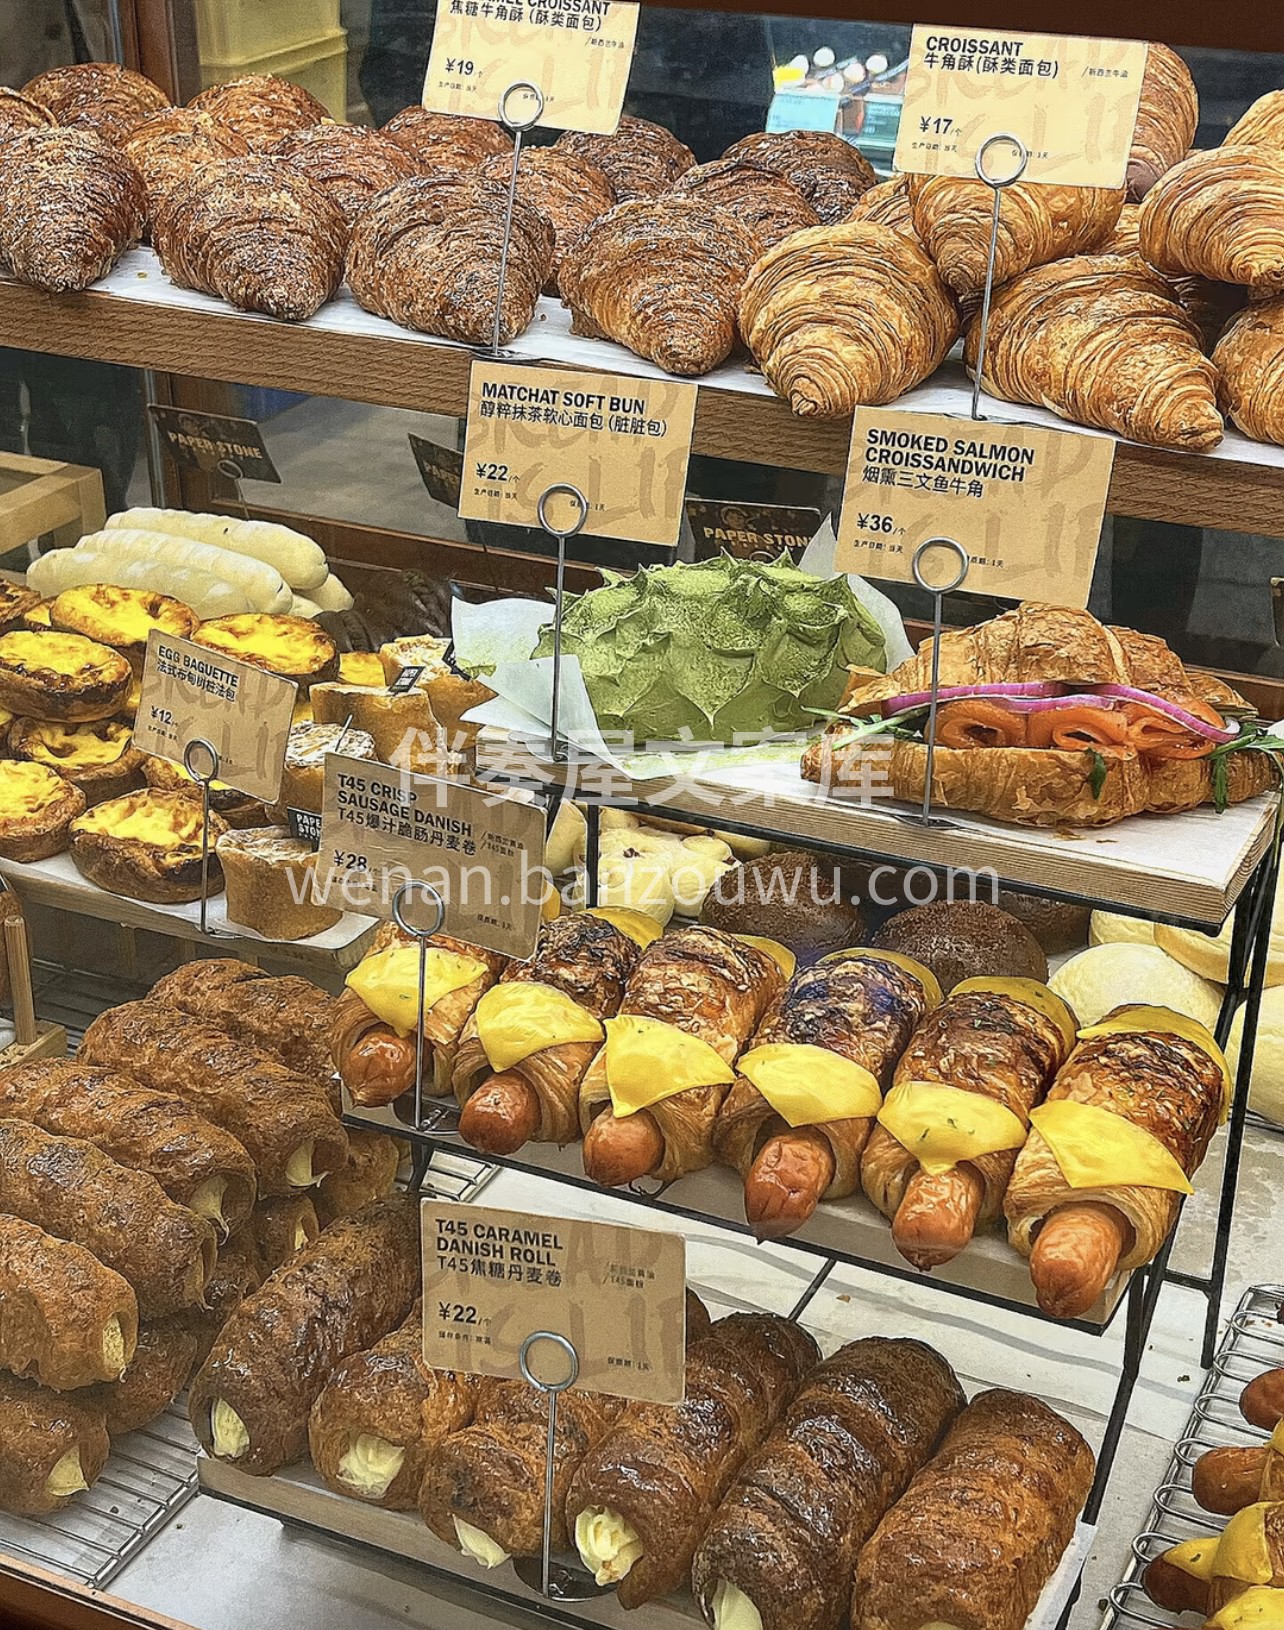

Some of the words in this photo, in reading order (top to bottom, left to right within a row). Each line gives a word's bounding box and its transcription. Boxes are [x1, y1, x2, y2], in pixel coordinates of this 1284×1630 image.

[926, 36, 1023, 56] CROISSANT
[482, 382, 559, 405] MATCHAT
[562, 391, 606, 410] SOFT
[609, 397, 645, 415] BUN
[867, 428, 948, 454] SMOKED
[952, 440, 1035, 465] SALMON
[865, 446, 1025, 482] CROISSANDWICH
[703, 526, 757, 543] PAPER
[763, 533, 812, 548] STON
[159, 646, 180, 664] EGG
[183, 655, 239, 687] BAGUETTE
[338, 773, 366, 792] T45
[370, 782, 417, 803] CRISP
[296, 813, 321, 829] PAPE
[338, 790, 410, 819] SAUSAGE
[414, 809, 473, 837] DANISH
[435, 1219, 468, 1236] T45
[473, 1224, 563, 1250] CARAMEL
[437, 1236, 504, 1259] DANISH
[510, 1246, 556, 1267] ROLL
[437, 1255, 562, 1287] T45焦糖丹麦卷
